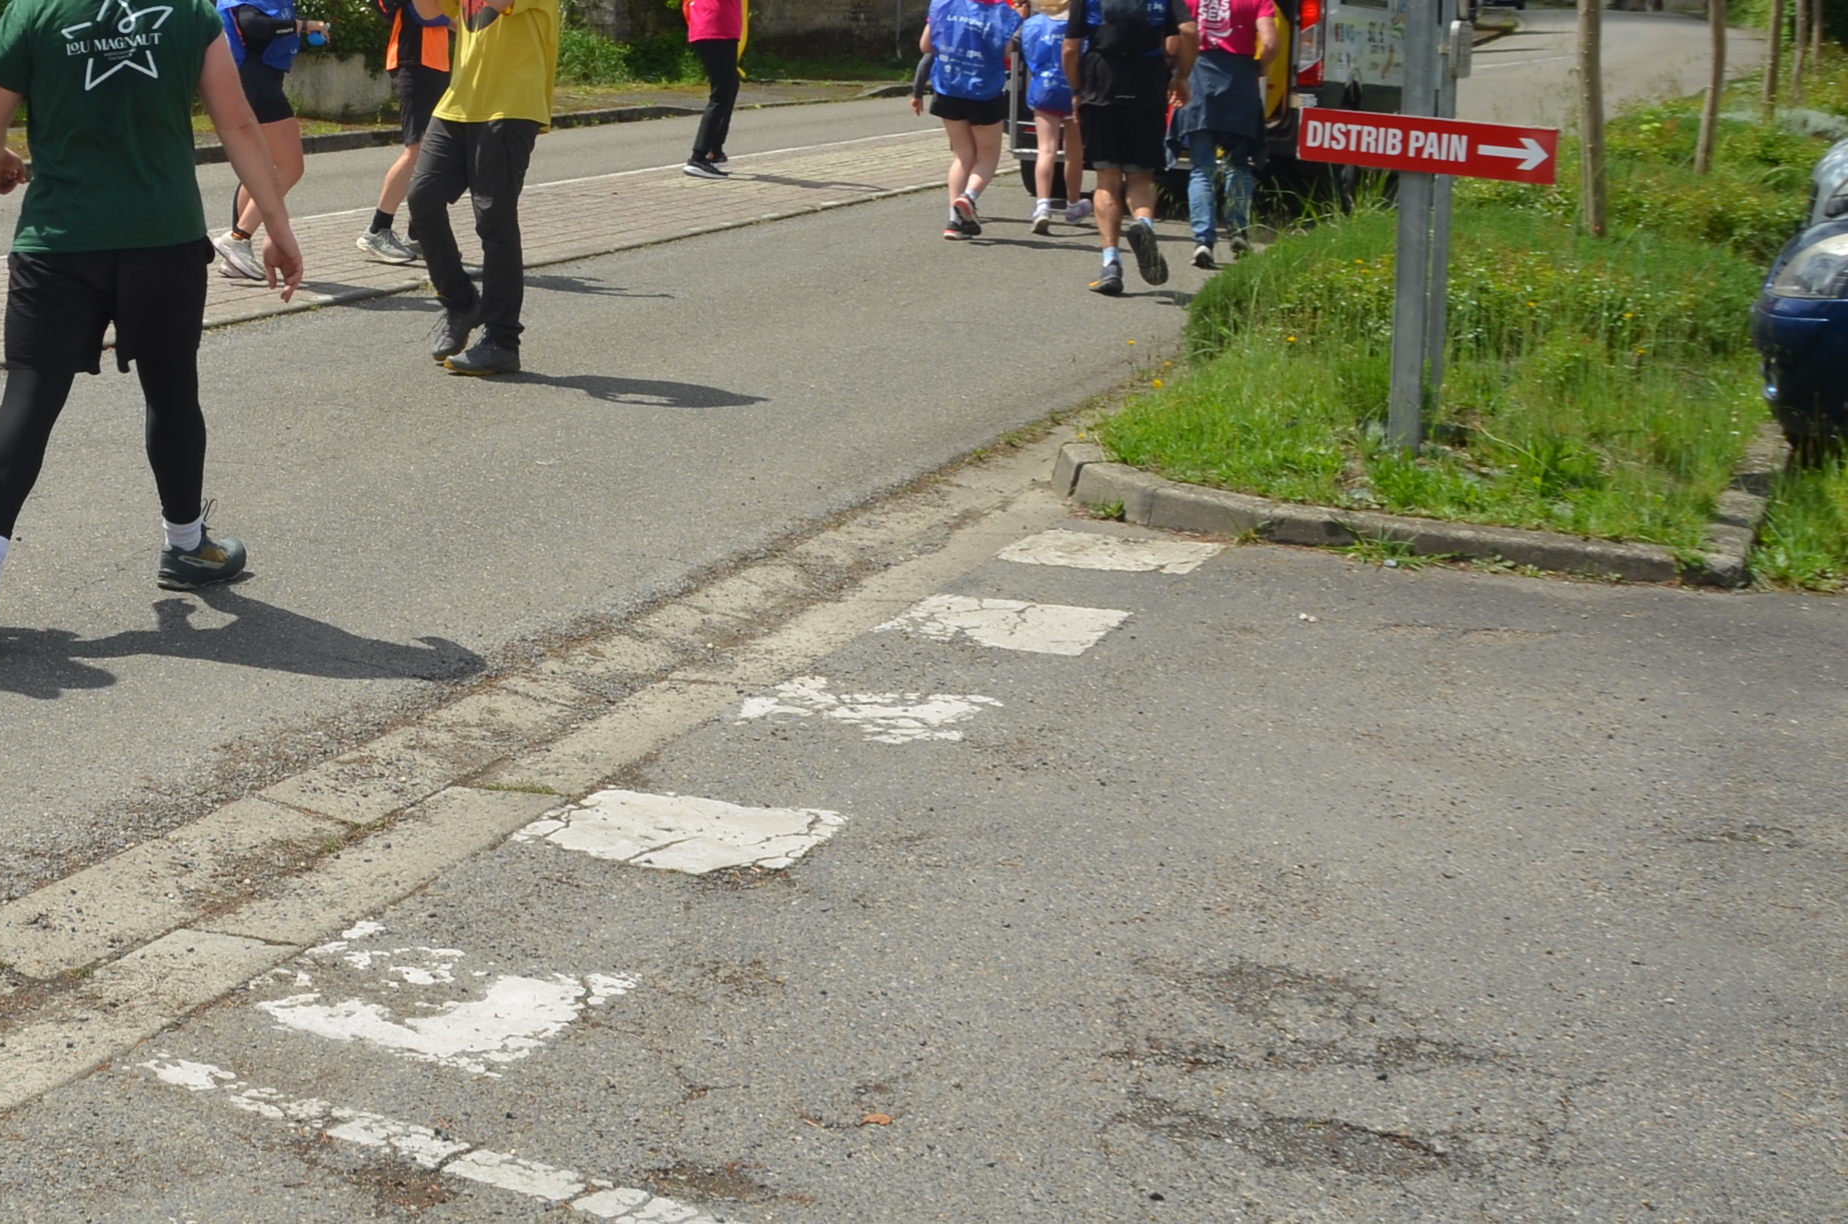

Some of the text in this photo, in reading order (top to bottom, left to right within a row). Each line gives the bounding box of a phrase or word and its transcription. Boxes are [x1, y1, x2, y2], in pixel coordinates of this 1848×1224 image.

[1197, 7, 1231, 21] SEM
[66, 40, 90, 56] LOU
[94, 33, 162, 52] MAGNAUT
[1306, 120, 1469, 163] DISTRIB PAIN
